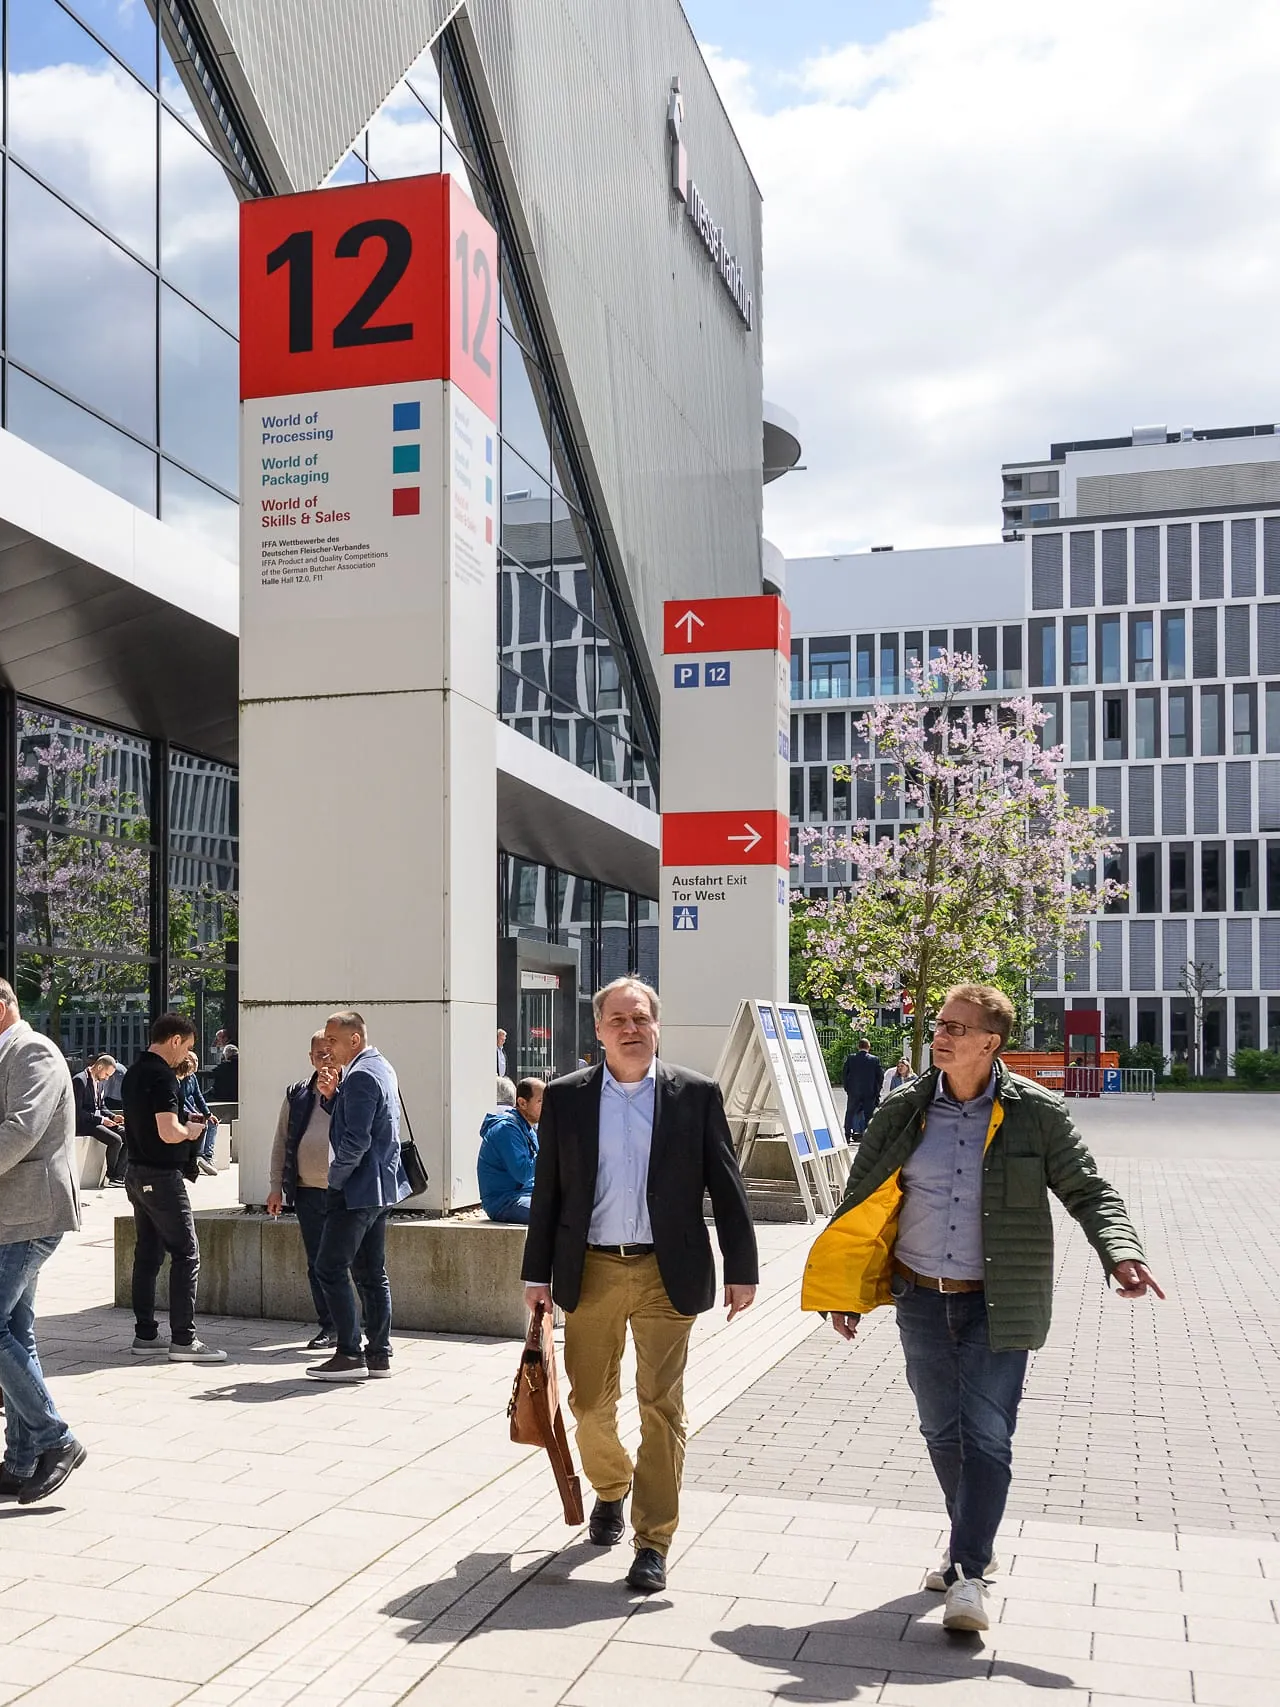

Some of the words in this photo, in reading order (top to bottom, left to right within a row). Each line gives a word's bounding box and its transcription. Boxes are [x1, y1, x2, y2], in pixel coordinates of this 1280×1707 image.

[267, 219, 413, 353] 12
[456, 230, 491, 378] 12
[262, 413, 300, 428] World
[305, 411, 318, 424] of
[262, 428, 333, 445] Processing
[262, 456, 300, 470] World
[305, 454, 318, 466] of
[262, 470, 329, 486] Packaging
[261, 497, 300, 511] World
[305, 495, 317, 508] of
[261, 514, 297, 528] Skills
[301, 512, 311, 524] &
[315, 510, 351, 523] Sales
[261, 540, 277, 548] IFFA
[279, 537, 325, 547] Wettbewerbe
[261, 549, 299, 557] Deutschen
[300, 544, 370, 555] Fleischer-Verbandes
[278, 557, 304, 565] Product
[319, 554, 343, 563] Quality
[344, 552, 389, 560] Competitions
[282, 567, 308, 575] German
[309, 564, 336, 572] Butcher
[337, 562, 376, 570] Association
[281, 576, 294, 584] Hall
[313, 574, 323, 582] F11
[680, 668, 693, 684] P
[709, 667, 726, 682] 12
[672, 875, 723, 886] Ausfahrt
[726, 874, 748, 886] Exit
[672, 890, 691, 901] Tor
[695, 890, 726, 901] West
[1106, 1070, 1118, 1083] P
